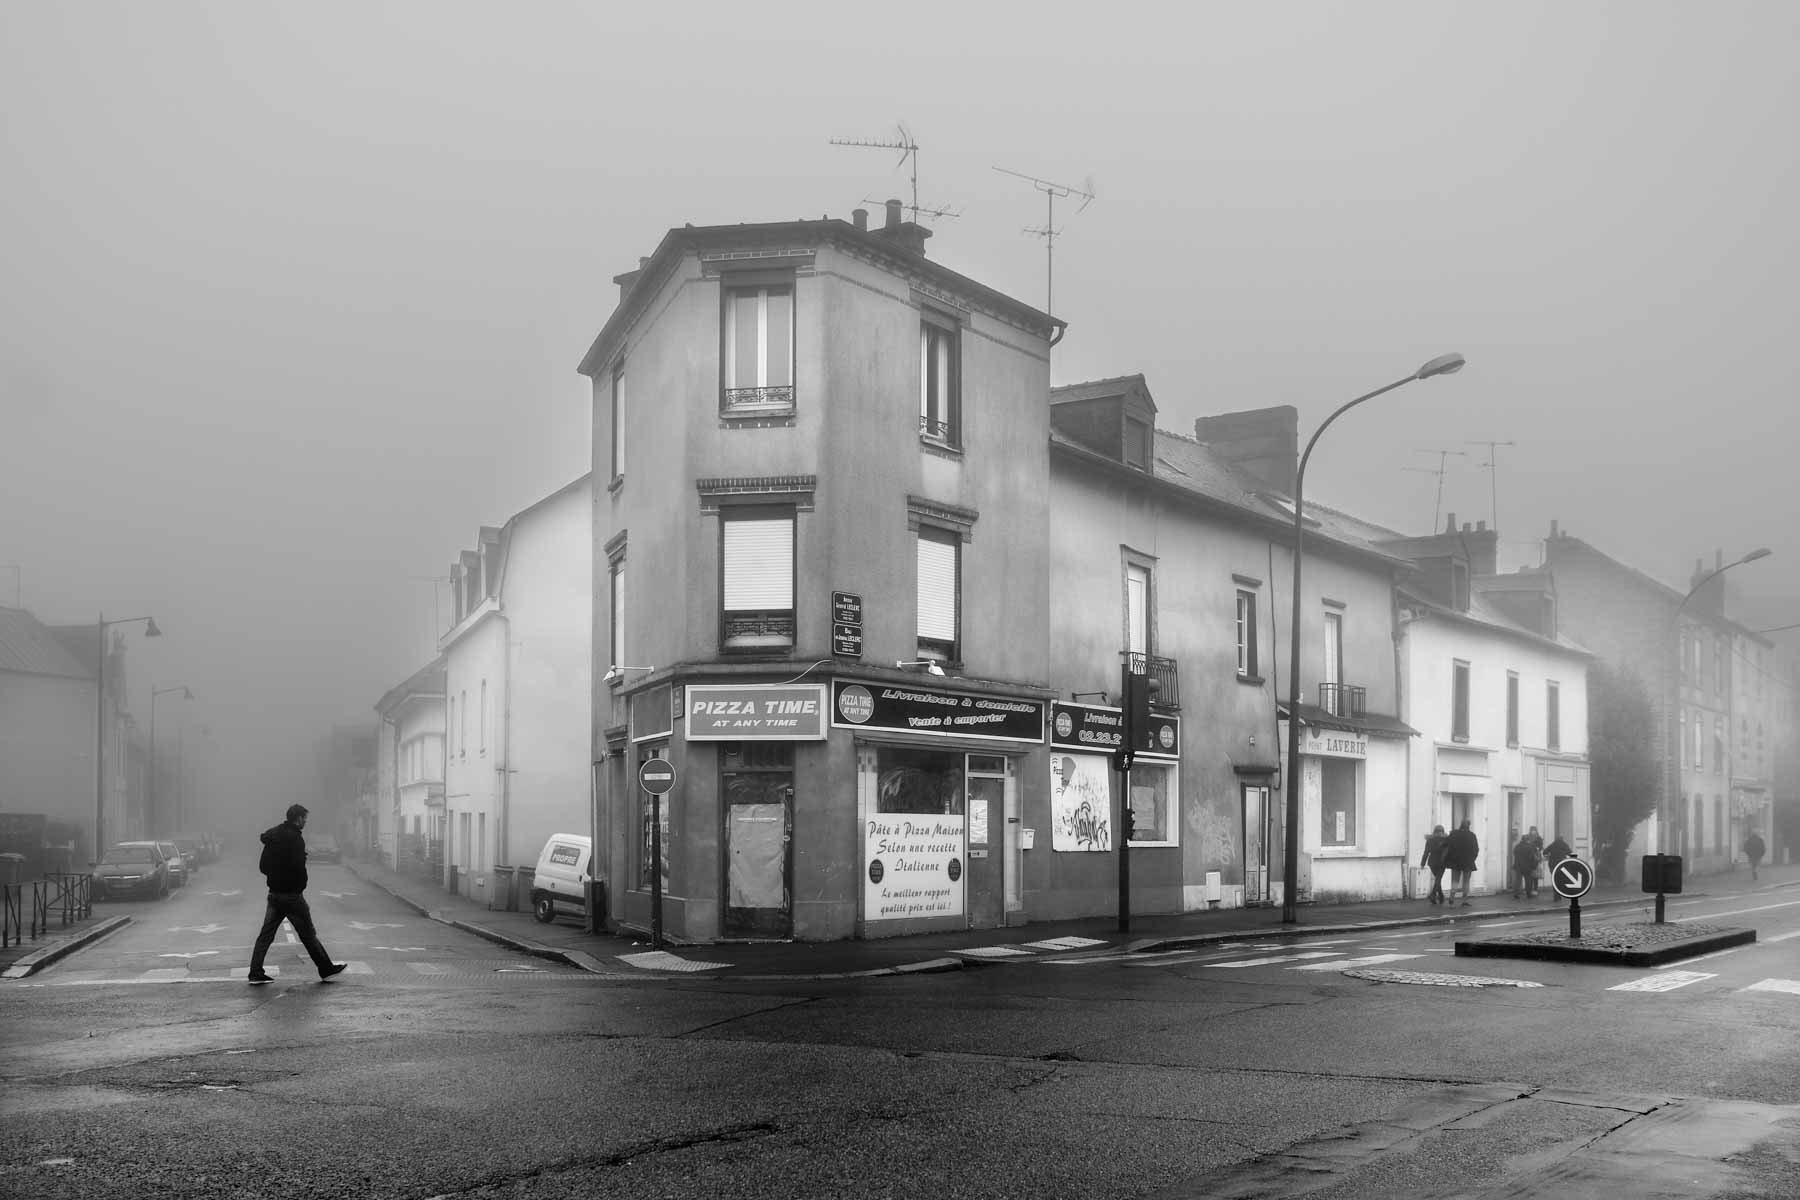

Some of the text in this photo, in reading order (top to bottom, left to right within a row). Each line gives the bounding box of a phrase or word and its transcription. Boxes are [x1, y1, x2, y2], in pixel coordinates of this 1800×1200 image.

[692, 701, 755, 715] PIZZA
[841, 694, 872, 708] PIZZA TIME
[882, 689, 1036, 713] Livraison à domicile
[733, 719, 762, 727] ANY
[766, 719, 798, 727] TIME
[908, 713, 1006, 727] Vente à emporter
[1084, 712, 1117, 726] Livraison
[1327, 738, 1366, 755] LAVERIE
[868, 821, 964, 838] Pâte à Pizza Maison
[876, 839, 956, 855] Selon une recette
[552, 854, 577, 865] PROPRE
[894, 858, 940, 872] Italienne
[881, 887, 951, 900] Le meilleur rapport
[880, 903, 906, 917] qualité
[908, 903, 923, 915] prix
[925, 903, 935, 911] est
